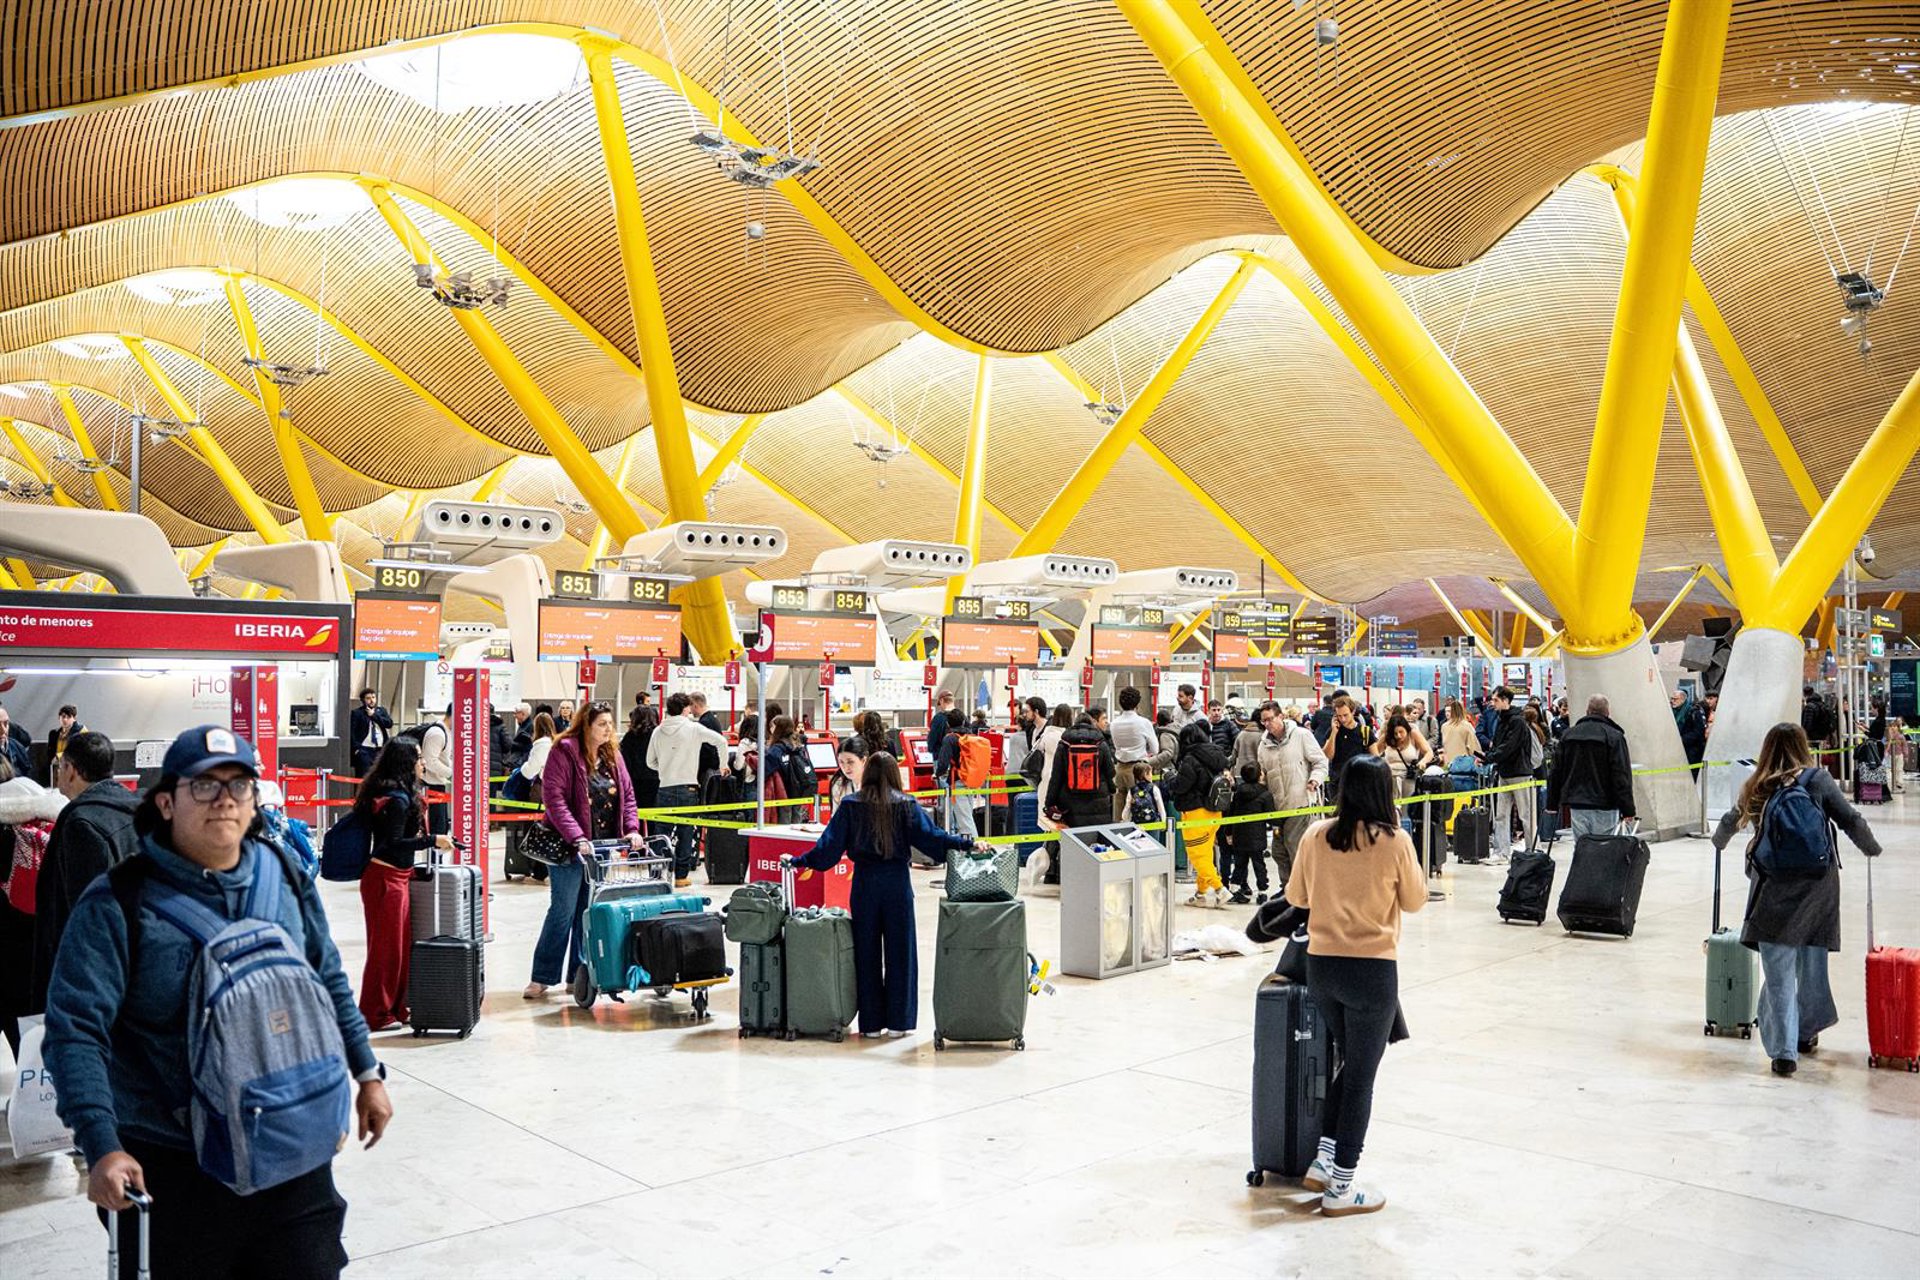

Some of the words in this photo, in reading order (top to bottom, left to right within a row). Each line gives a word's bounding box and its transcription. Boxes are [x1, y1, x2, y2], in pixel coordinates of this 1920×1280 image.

[382, 568, 420, 588] 850
[561, 575, 592, 594] 851
[633, 581, 665, 600] 852
[778, 589, 805, 606] 853
[836, 593, 864, 609] 854
[958, 599, 980, 614] 855
[21, 614, 36, 626] de
[40, 617, 93, 628] menores
[1103, 608, 1122, 622] 857
[1143, 610, 1162, 624] 858
[1224, 614, 1241, 628] 859
[235, 624, 305, 638] IBERIA
[585, 667, 591, 676] 1
[658, 666, 664, 675] 2
[824, 670, 830, 679] 4
[928, 671, 933, 680] 5
[1010, 671, 1016, 680] 6
[1085, 672, 1091, 680] 7
[461, 698, 474, 792] acompañados
[463, 794, 472, 811] no
[834, 864, 847, 875] IB
[1354, 1193, 1365, 1204] N
